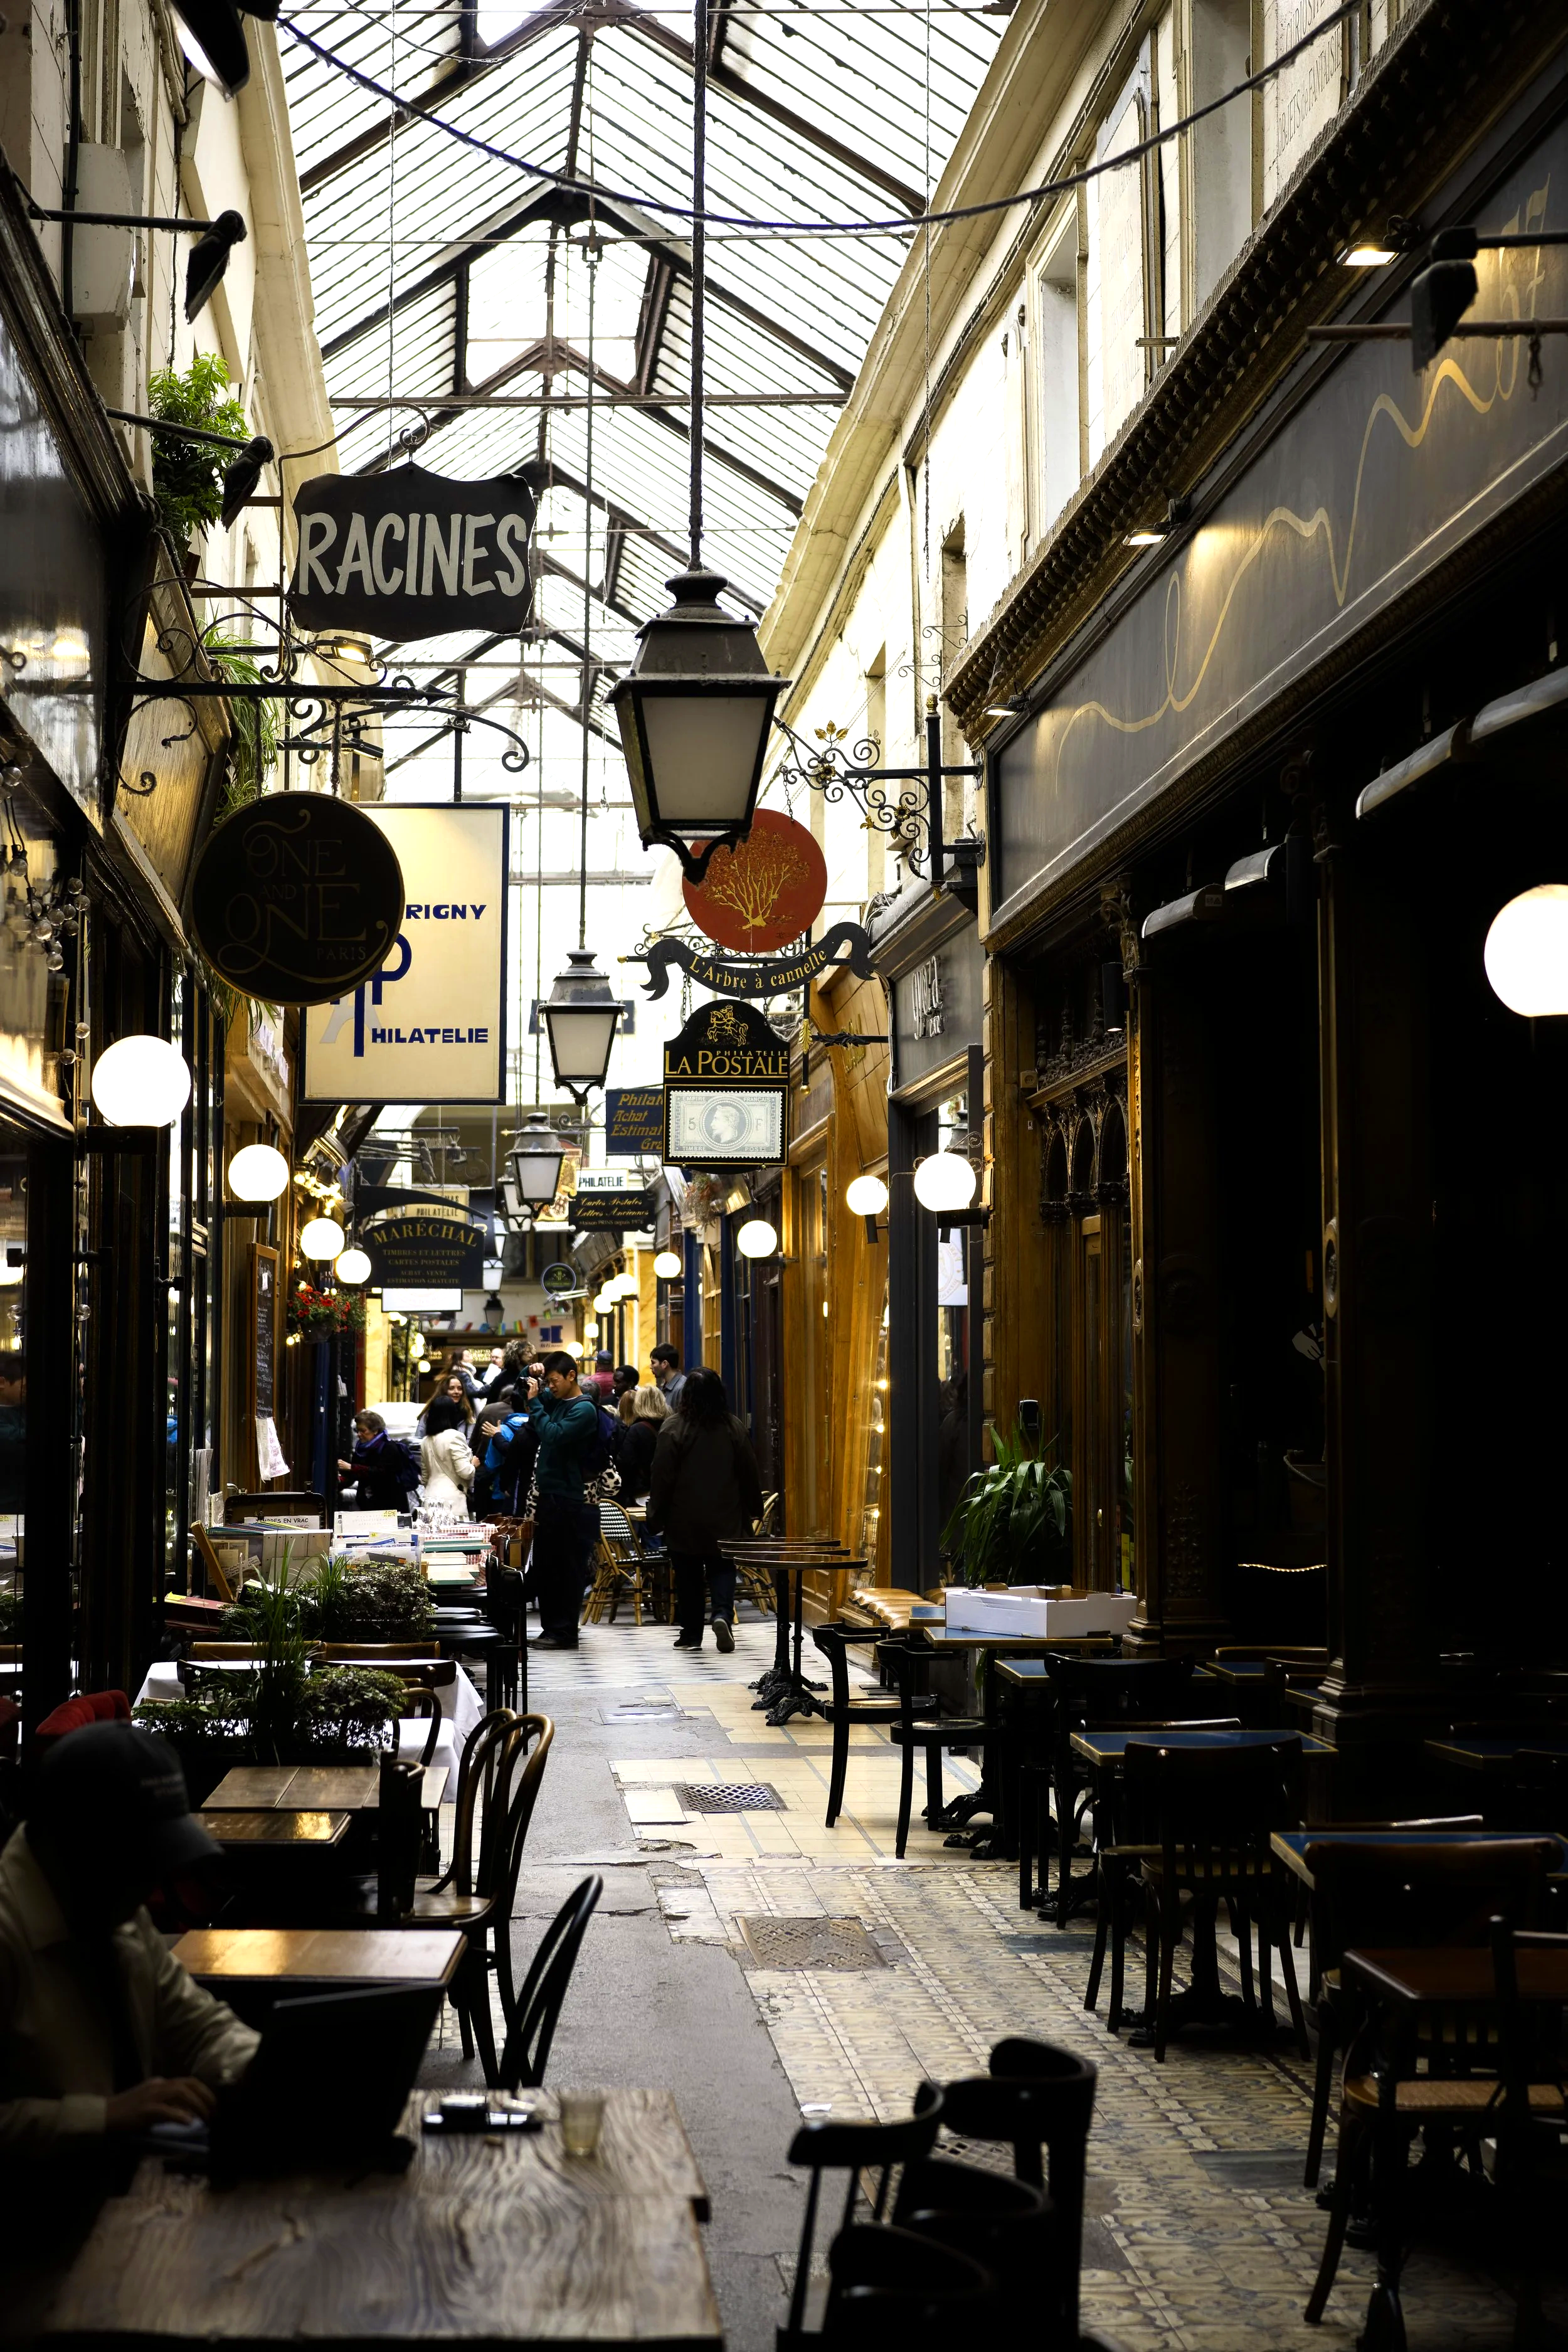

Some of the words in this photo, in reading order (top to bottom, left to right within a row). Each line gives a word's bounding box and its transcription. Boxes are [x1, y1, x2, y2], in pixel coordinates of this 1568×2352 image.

[299, 512, 527, 596] RACINES
[242, 813, 346, 878] ONE
[258, 883, 297, 901] AND
[405, 904, 487, 920] RIGNY
[316, 946, 368, 961] PARIS
[689, 955, 747, 989] L'Arbre
[755, 972, 764, 989] à
[770, 950, 827, 987] cannelle
[665, 1051, 691, 1074] LA
[698, 1051, 788, 1074] POSTALE
[618, 1093, 663, 1106] Philat
[613, 1110, 649, 1121] Achat
[688, 1117, 696, 1130] 5
[755, 1118, 763, 1131] F
[579, 1176, 624, 1187] PHILATELIE
[580, 1197, 606, 1206] Cartes
[609, 1197, 643, 1206] Postales
[416, 1207, 458, 1217] PHILATELIE
[575, 1207, 603, 1217] Lettres
[607, 1207, 649, 1217] Anciennes
[373, 1219, 477, 1247] MARÉCHAL
